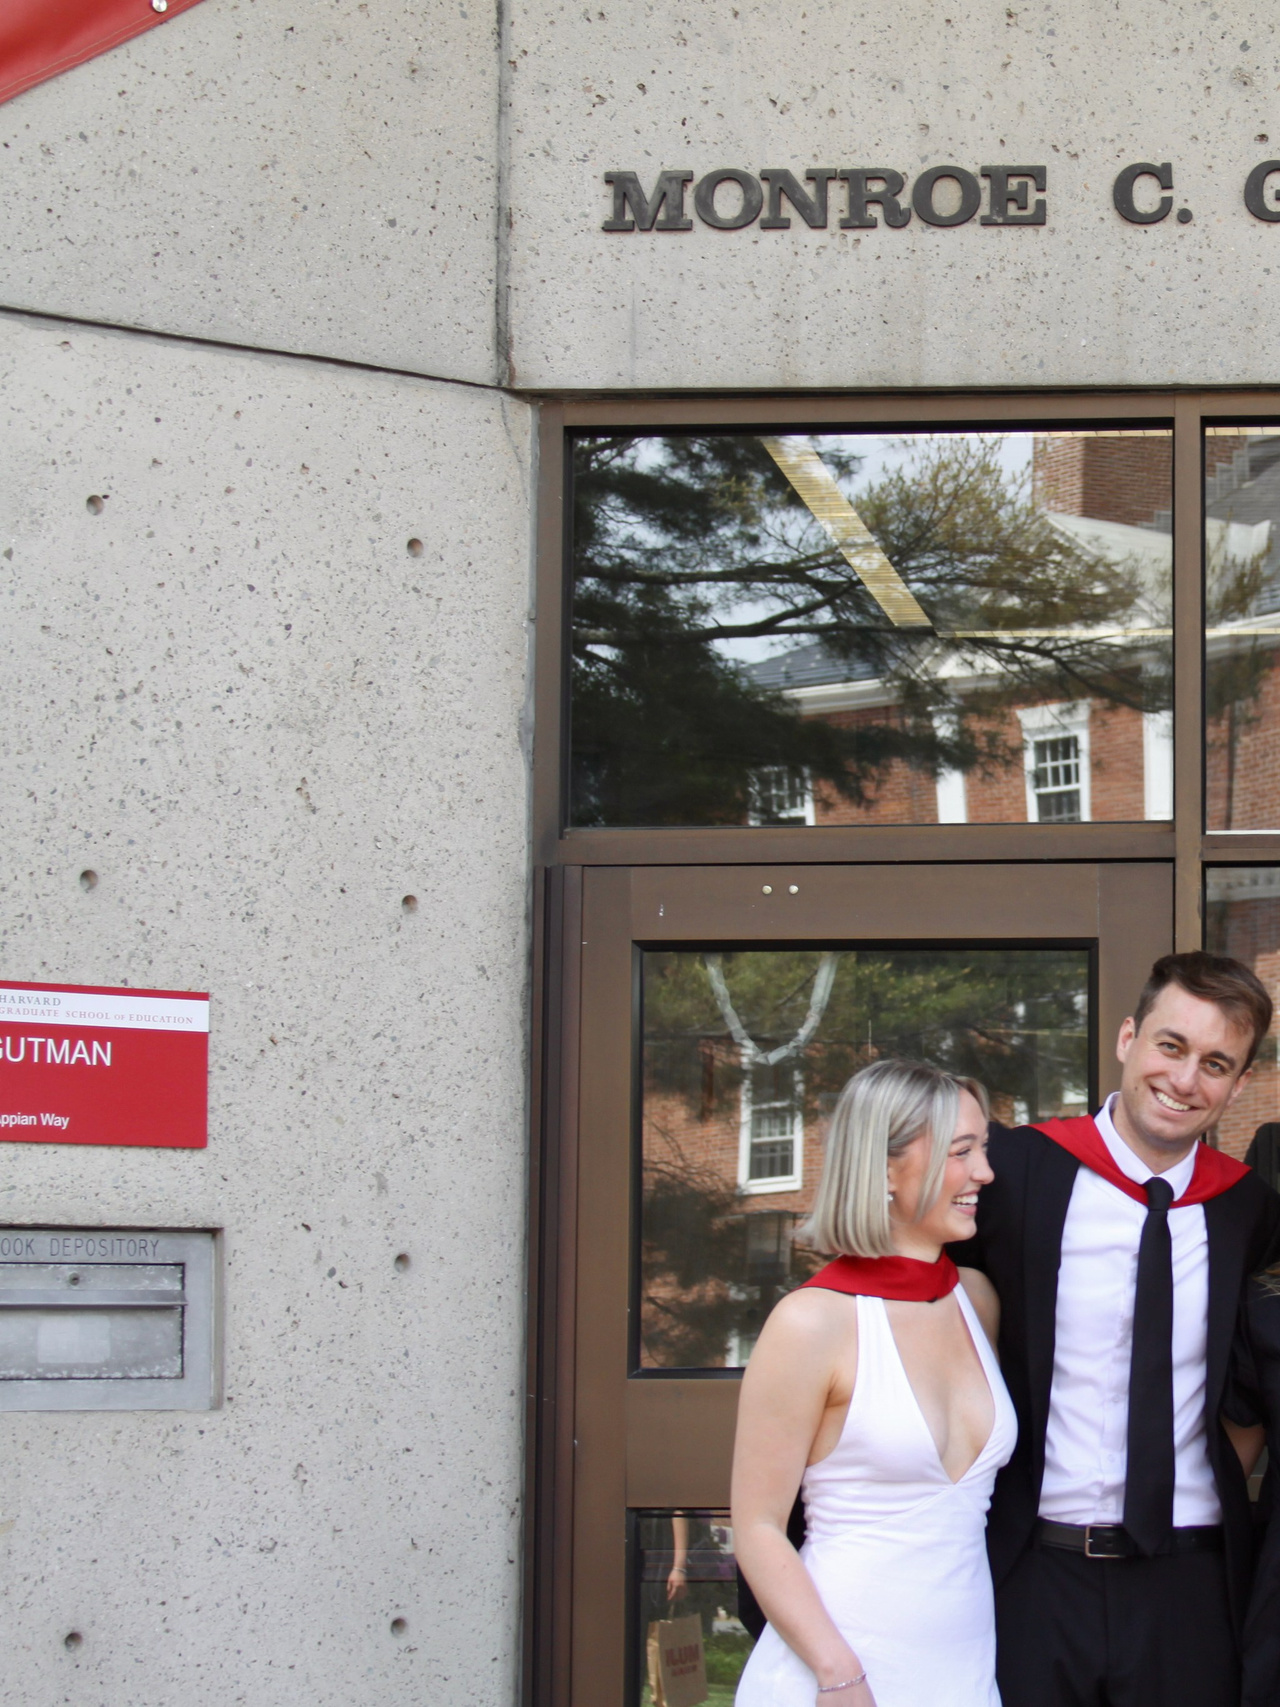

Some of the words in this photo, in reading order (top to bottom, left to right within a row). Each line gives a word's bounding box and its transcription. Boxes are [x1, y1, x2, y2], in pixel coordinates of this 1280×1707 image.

[602, 164, 1047, 232] MONROE
[1113, 162, 1194, 225] C.
[0, 994, 61, 1006] HARVARD
[0, 1006, 60, 1017] GRADUATE
[65, 1010, 111, 1020] SCHOOL
[129, 1013, 194, 1025] EDUCATION
[0, 1036, 112, 1066] UTMAN
[0, 1112, 37, 1128] ppian
[40, 1112, 70, 1130] Way
[0, 1237, 36, 1257] OOK
[49, 1237, 160, 1258] DEPOSITORY
